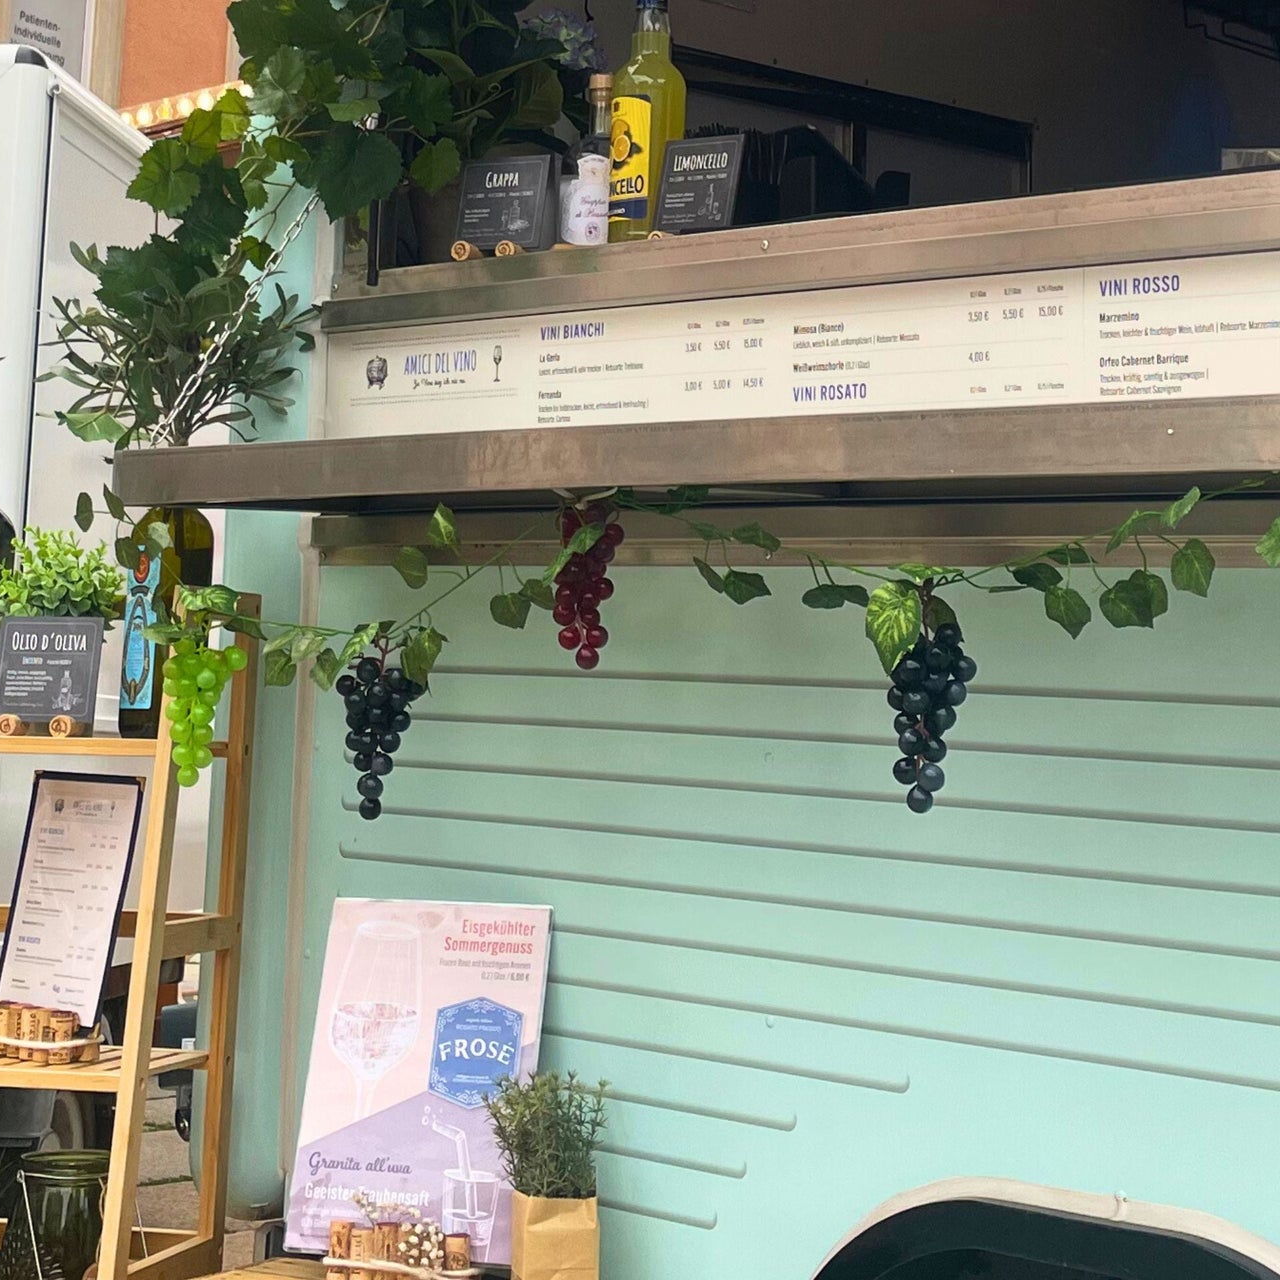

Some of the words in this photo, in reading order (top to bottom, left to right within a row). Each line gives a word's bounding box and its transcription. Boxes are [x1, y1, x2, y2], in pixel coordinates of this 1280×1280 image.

[20, 10, 61, 31] Patienten-
[673, 152, 728, 171] LIMONCELLO
[485, 172, 519, 189] GRAPPA
[609, 174, 644, 196] NCELLO
[1099, 278, 1128, 297] VINI
[1132, 274, 1180, 295] ROSSO
[1099, 312, 1140, 323] Marzemino
[540, 325, 561, 341] VINI
[563, 322, 605, 340] BIANCHI
[404, 353, 432, 376] AMICI
[435, 352, 450, 373] DEL
[453, 349, 477, 372] VINO
[1099, 356, 1120, 368] Orfeo
[1121, 354, 1155, 366] Cabernet
[1156, 353, 1189, 365] Barrique
[793, 385, 816, 402] VINI
[820, 383, 867, 401] ROSATO
[12, 631, 38, 650] OLIO
[462, 919, 536, 938] Eisgekühlter
[444, 936, 533, 956] Sommergenuss
[439, 1038, 515, 1065] FROSÉ
[308, 1151, 362, 1176] Granita
[365, 1157, 412, 1174] all'uva
